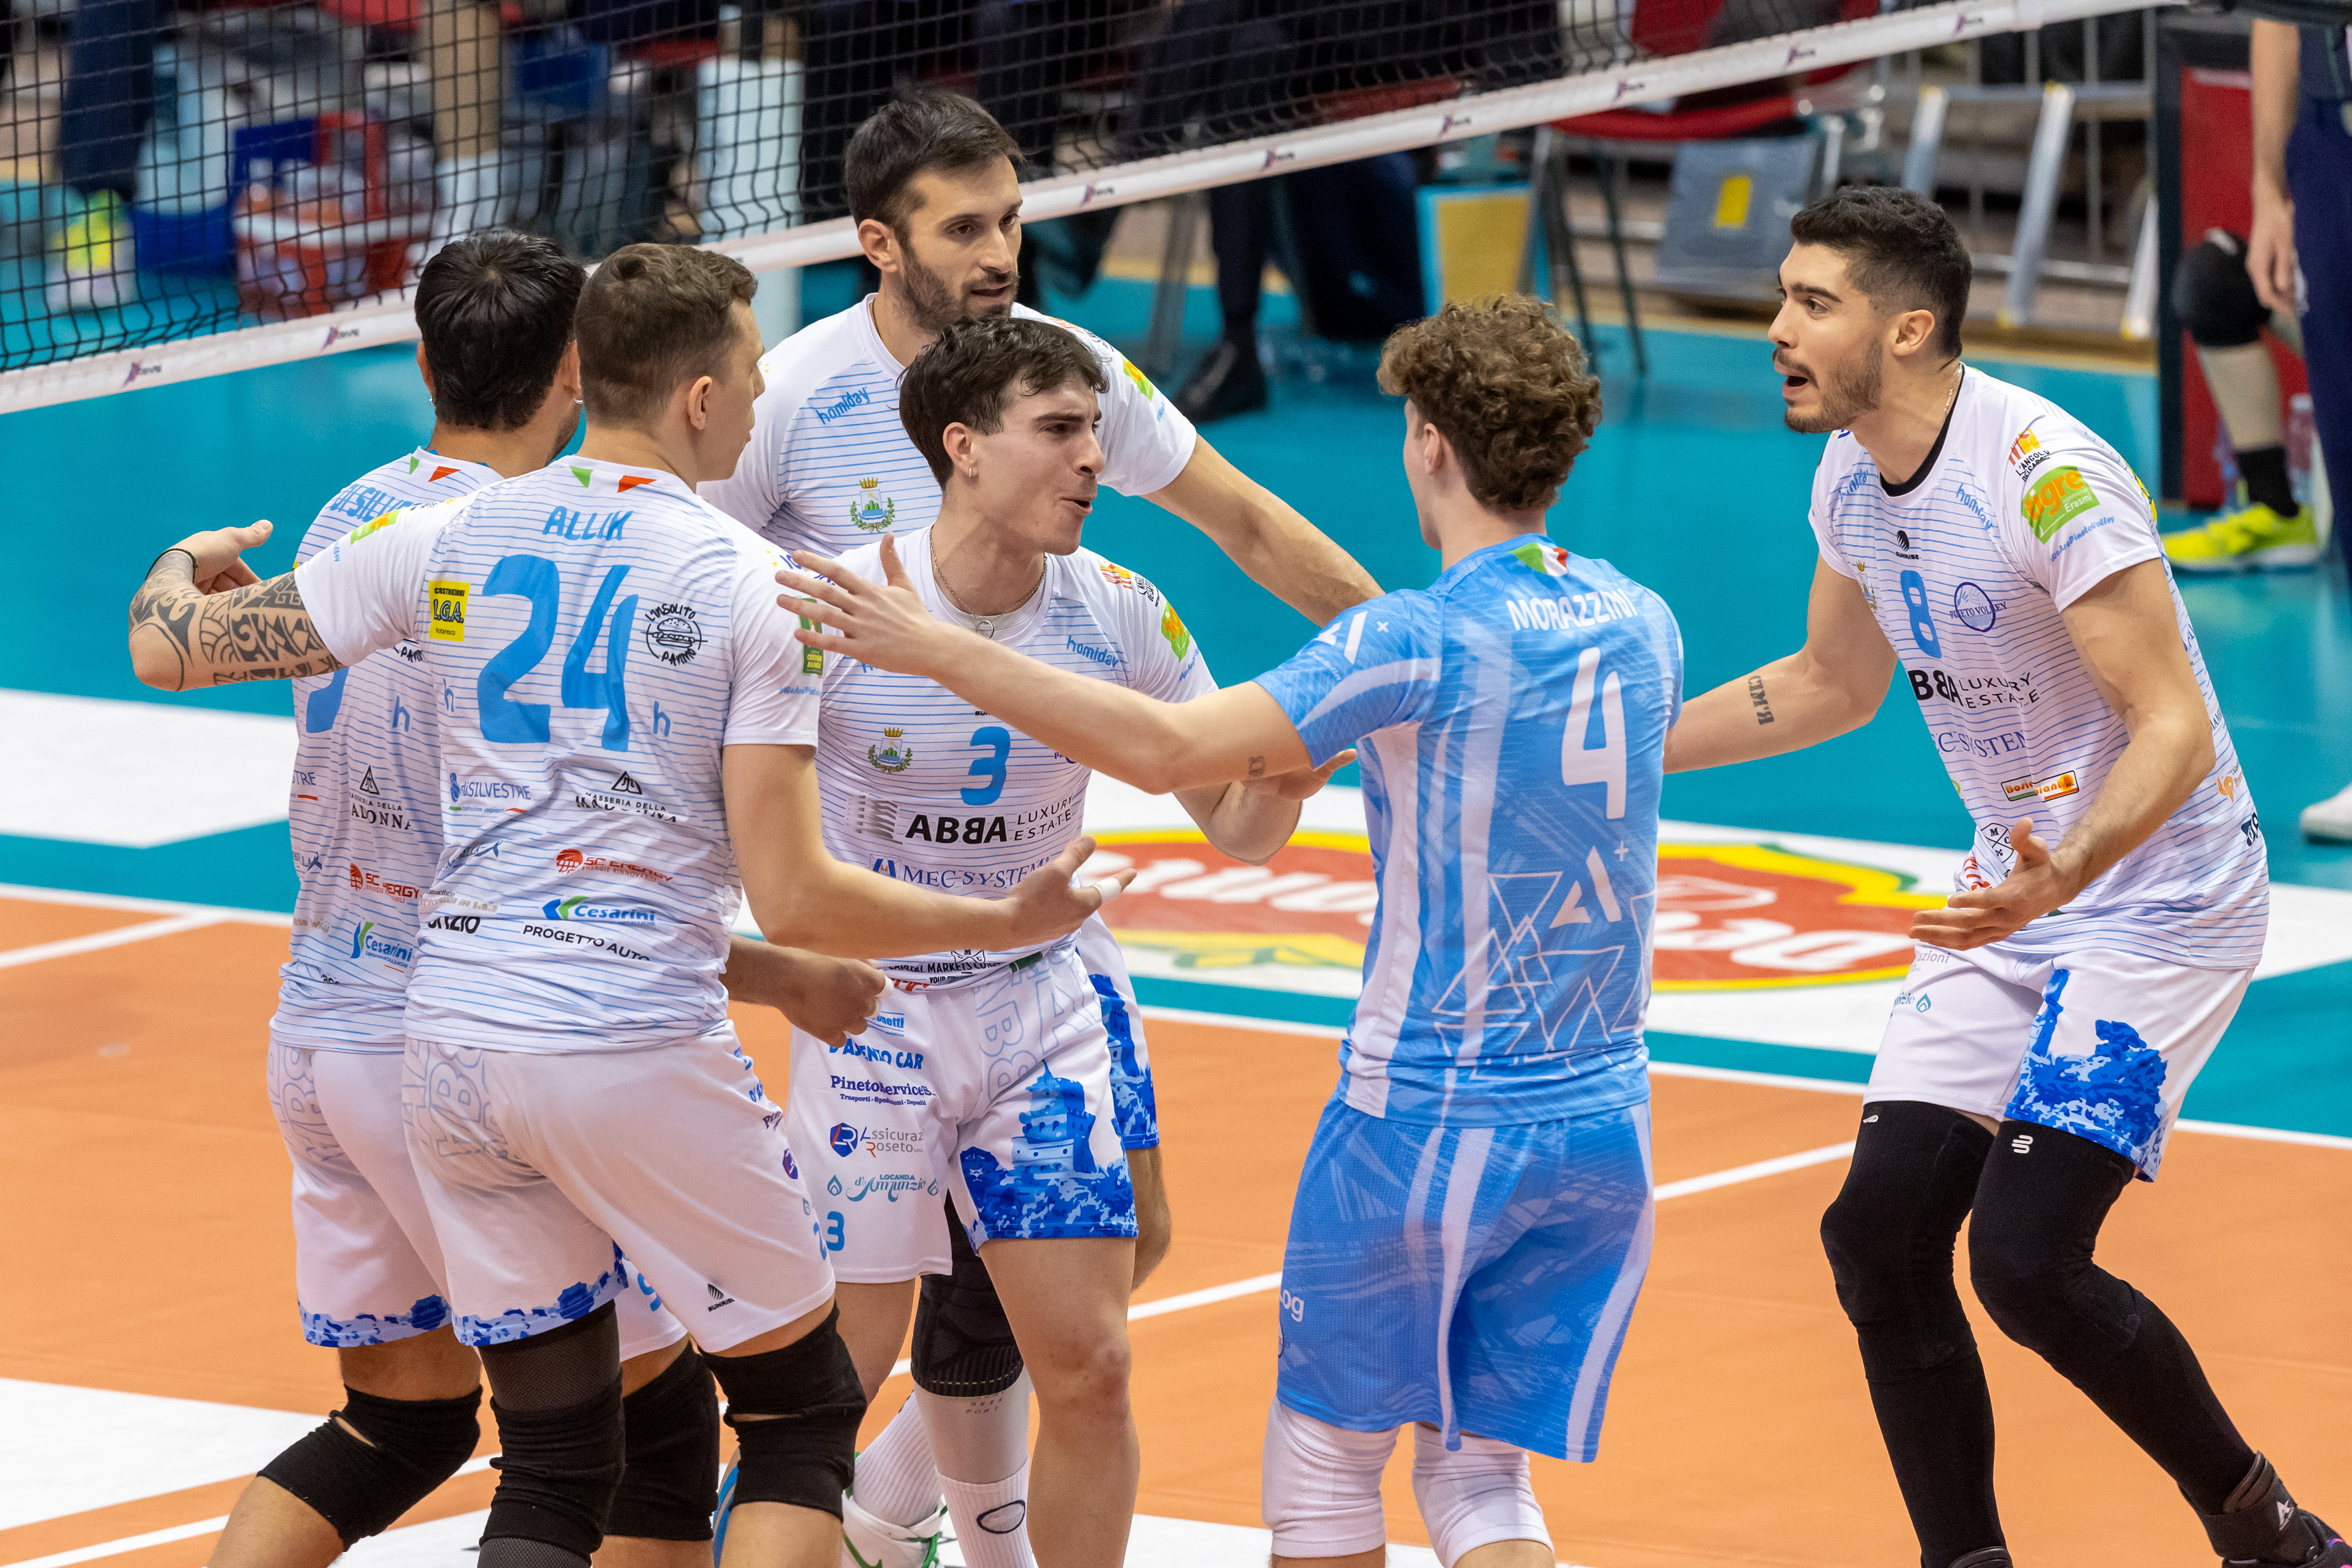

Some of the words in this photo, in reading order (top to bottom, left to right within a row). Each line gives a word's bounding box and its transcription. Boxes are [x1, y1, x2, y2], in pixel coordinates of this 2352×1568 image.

[2025, 471, 2084, 521] tigre
[2064, 493, 2092, 512] Erasmi
[542, 506, 634, 540] ALLIK
[1506, 588, 1639, 633] MORAZZINI
[1901, 570, 1942, 659] 8
[477, 554, 639, 752] 24
[1066, 635, 1119, 667] homiday
[1907, 670, 1964, 706] BBA
[1958, 672, 2031, 692] LUXURY
[1965, 689, 2040, 708] ESTATE
[1561, 647, 1628, 820] 4
[961, 726, 1010, 805] 3
[378, 802, 402, 811] DELLA
[636, 802, 666, 811] DELLA
[905, 815, 1008, 844] ABBA
[1016, 793, 1074, 825] LUXURY
[1014, 809, 1071, 841] ESTATE
[902, 864, 957, 888] MEC
[574, 905, 655, 921] Cesarini
[366, 935, 413, 962] Cesarini
[522, 925, 605, 947] PROGETTO
[896, 1052, 923, 1069] CAR
[840, 1093, 870, 1102] Trasporti
[866, 1142, 913, 1158] Roseto
[826, 1211, 844, 1251] 3
